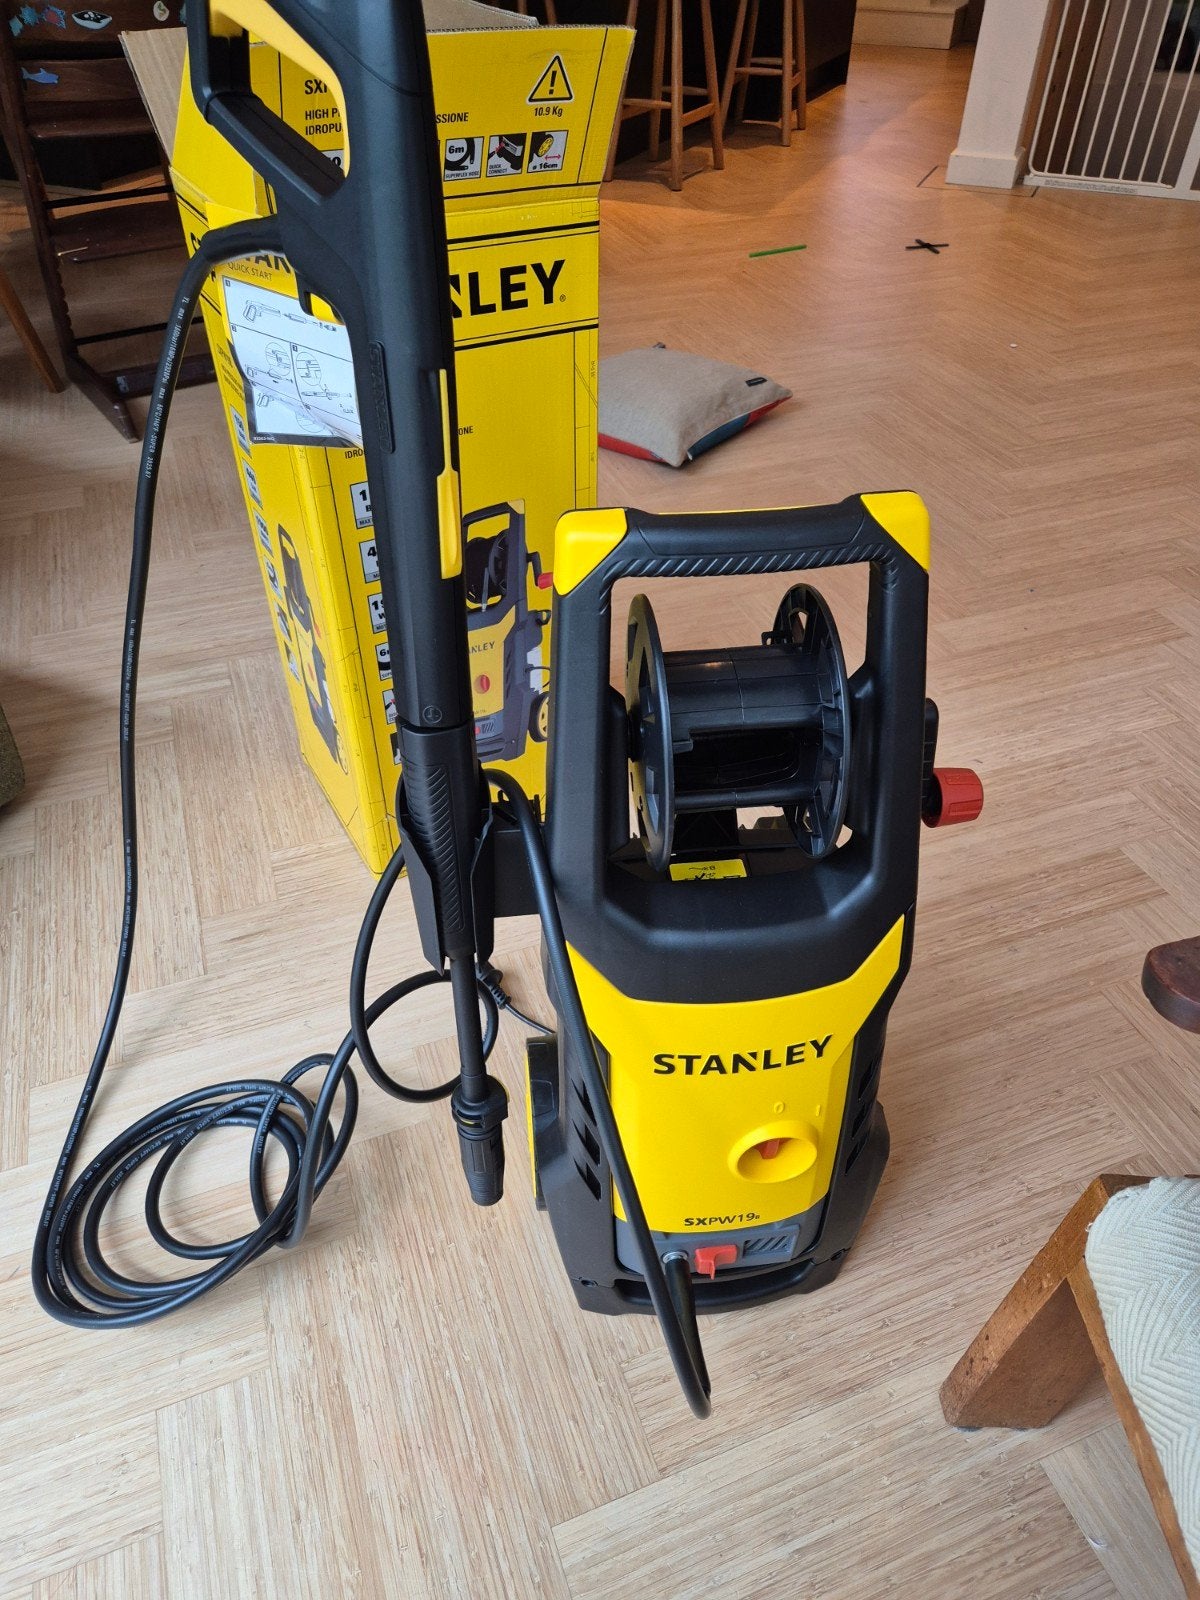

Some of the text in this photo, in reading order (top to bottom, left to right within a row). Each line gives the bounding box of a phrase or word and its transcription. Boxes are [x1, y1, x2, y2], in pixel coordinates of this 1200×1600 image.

[305, 109, 329, 120] HIGH
[534, 106, 563, 117] 10.9 Kg
[305, 122, 343, 135] IDROPU
[448, 145, 465, 154] 6m
[228, 262, 272, 280] QUICK START
[653, 1034, 834, 1076] STANLEY
